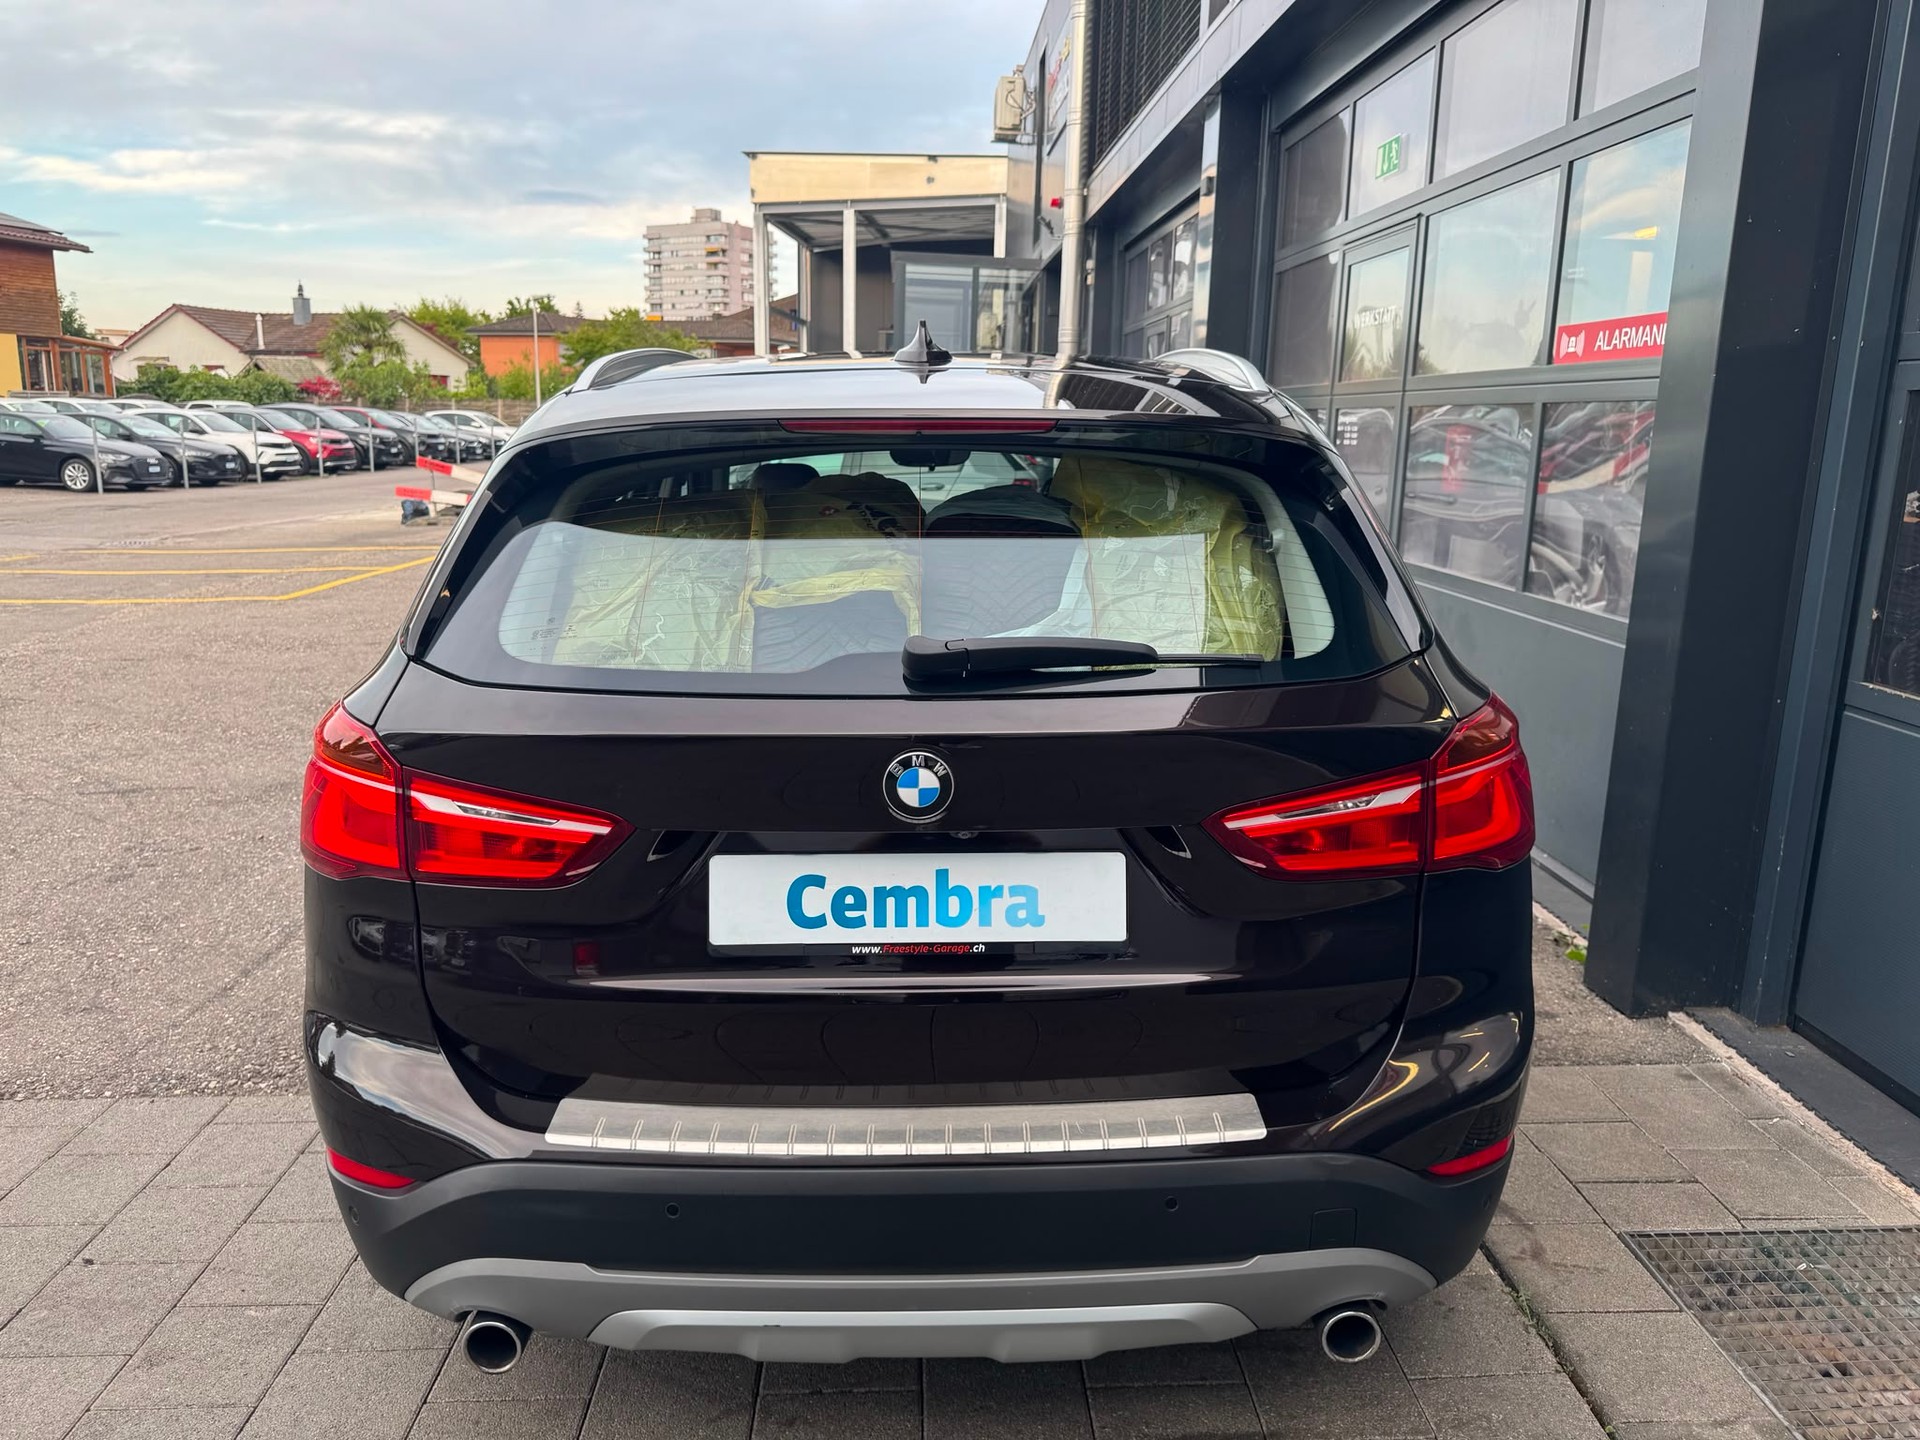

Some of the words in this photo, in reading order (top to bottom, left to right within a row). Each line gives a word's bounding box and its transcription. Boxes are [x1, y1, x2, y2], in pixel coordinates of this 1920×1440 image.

[889, 755, 948, 778] BMW
[786, 868, 1046, 930] Cembra
[851, 943, 986, 955] www.Freestyle-Garage.ch
